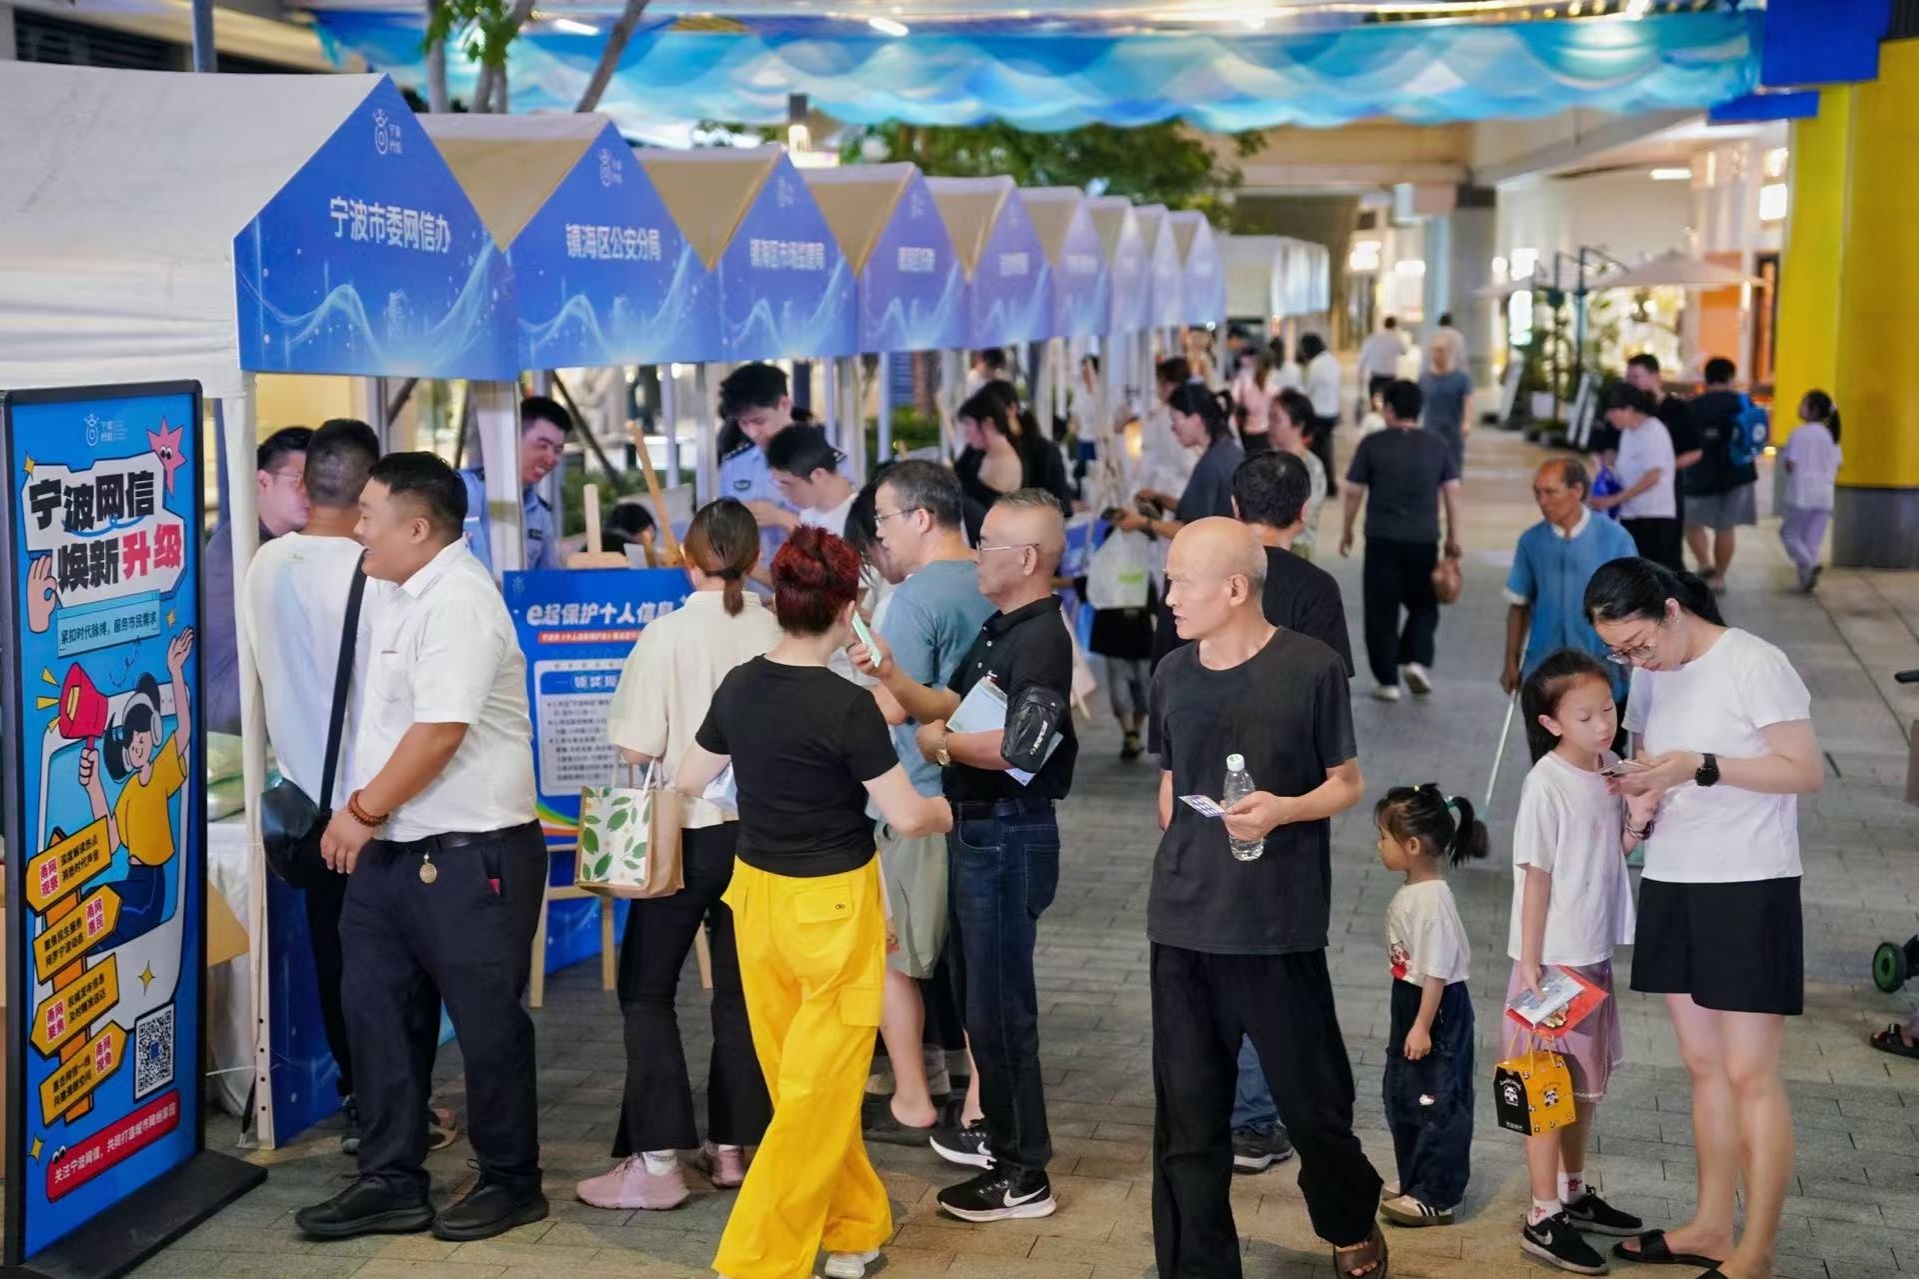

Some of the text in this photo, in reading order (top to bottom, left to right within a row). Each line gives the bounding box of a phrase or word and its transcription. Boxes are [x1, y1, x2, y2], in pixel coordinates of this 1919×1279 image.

[330, 196, 451, 253] 宁波市委网信办
[565, 223, 662, 261] 镇海区公安分局
[29, 471, 154, 532] 宁波网信
[58, 524, 182, 594] 焕新升级
